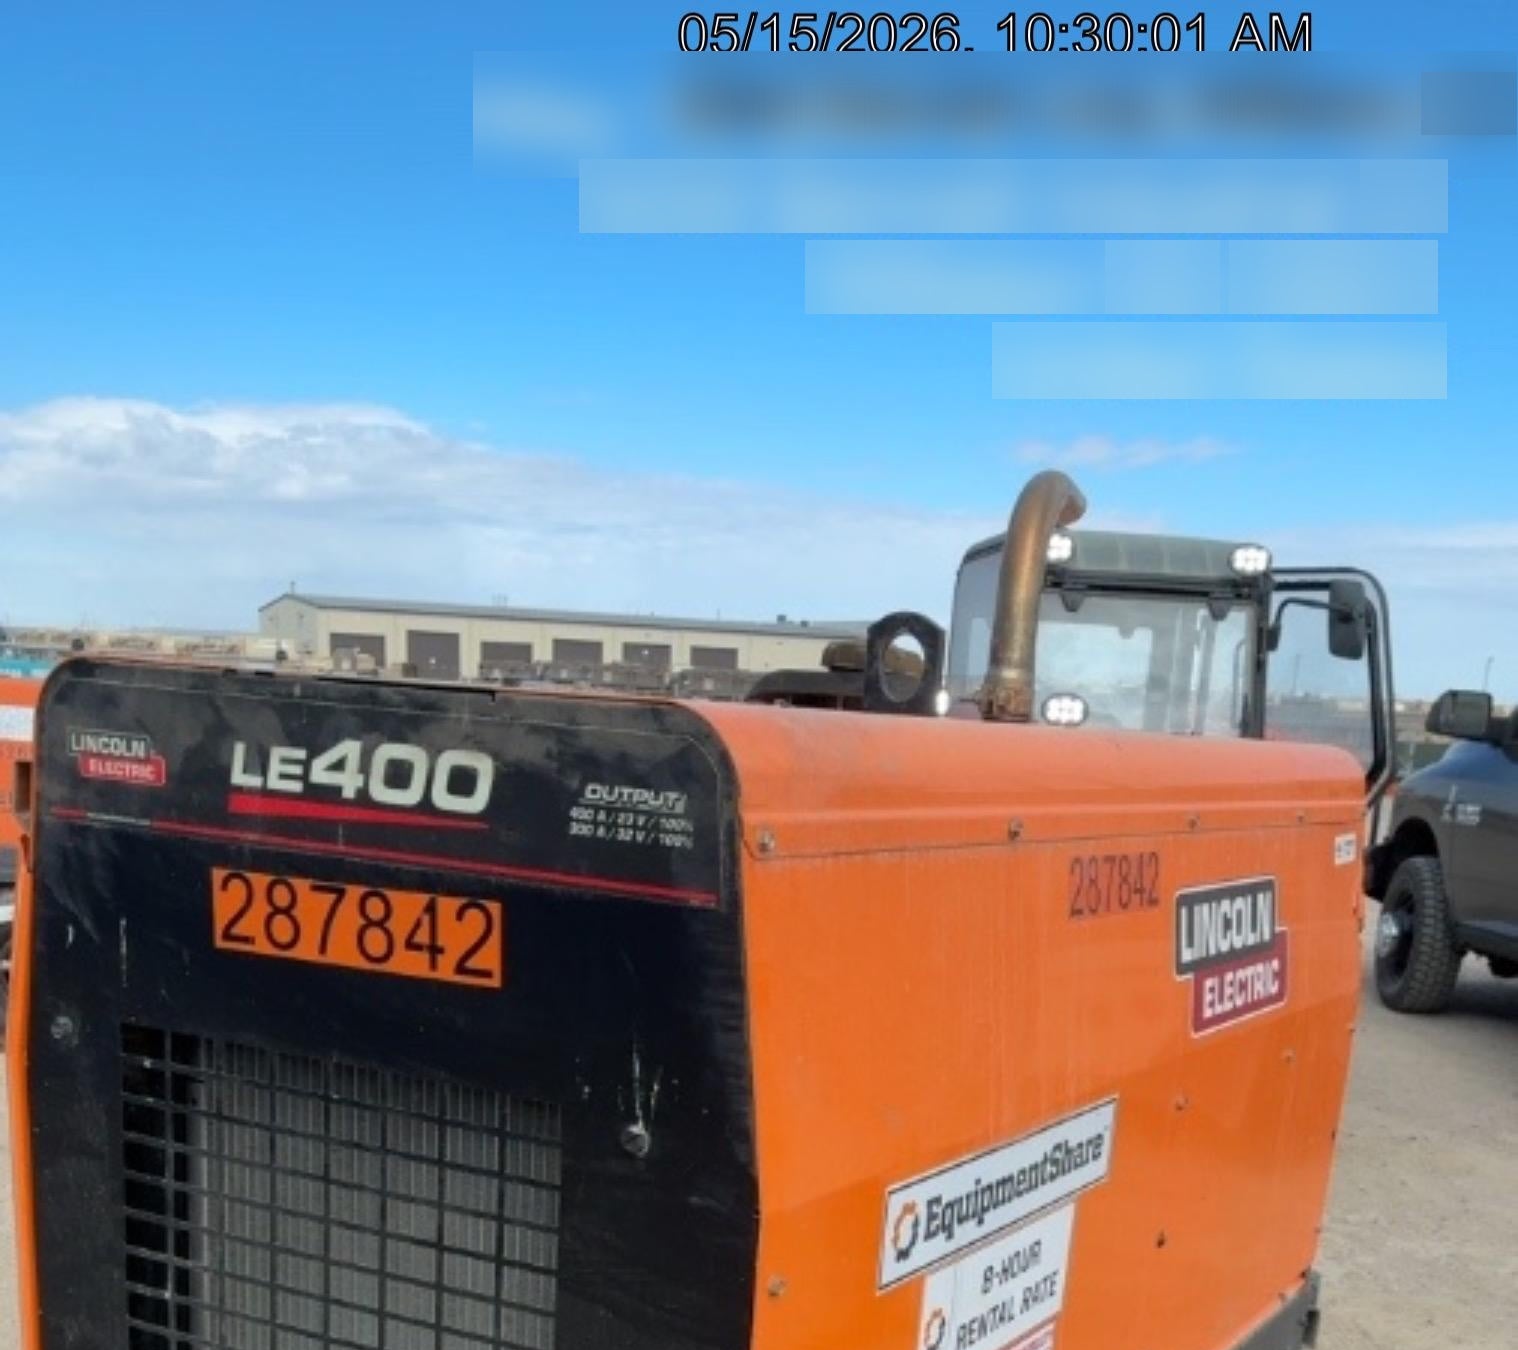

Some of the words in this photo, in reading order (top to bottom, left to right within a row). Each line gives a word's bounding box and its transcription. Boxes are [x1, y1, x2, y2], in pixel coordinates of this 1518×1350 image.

[71, 732, 146, 760] LINCOLN
[87, 757, 158, 781] ELECTRIC
[230, 740, 495, 815] LE400
[1068, 852, 1160, 919] 287842
[220, 873, 495, 981] 287842
[1179, 891, 1273, 964] LINCOLN
[1202, 959, 1281, 1019] ELECTRIC
[922, 1132, 1104, 1243] EquipmentShare
[980, 1240, 1042, 1295] 8-HOUR
[1022, 1269, 1059, 1313] RATE
